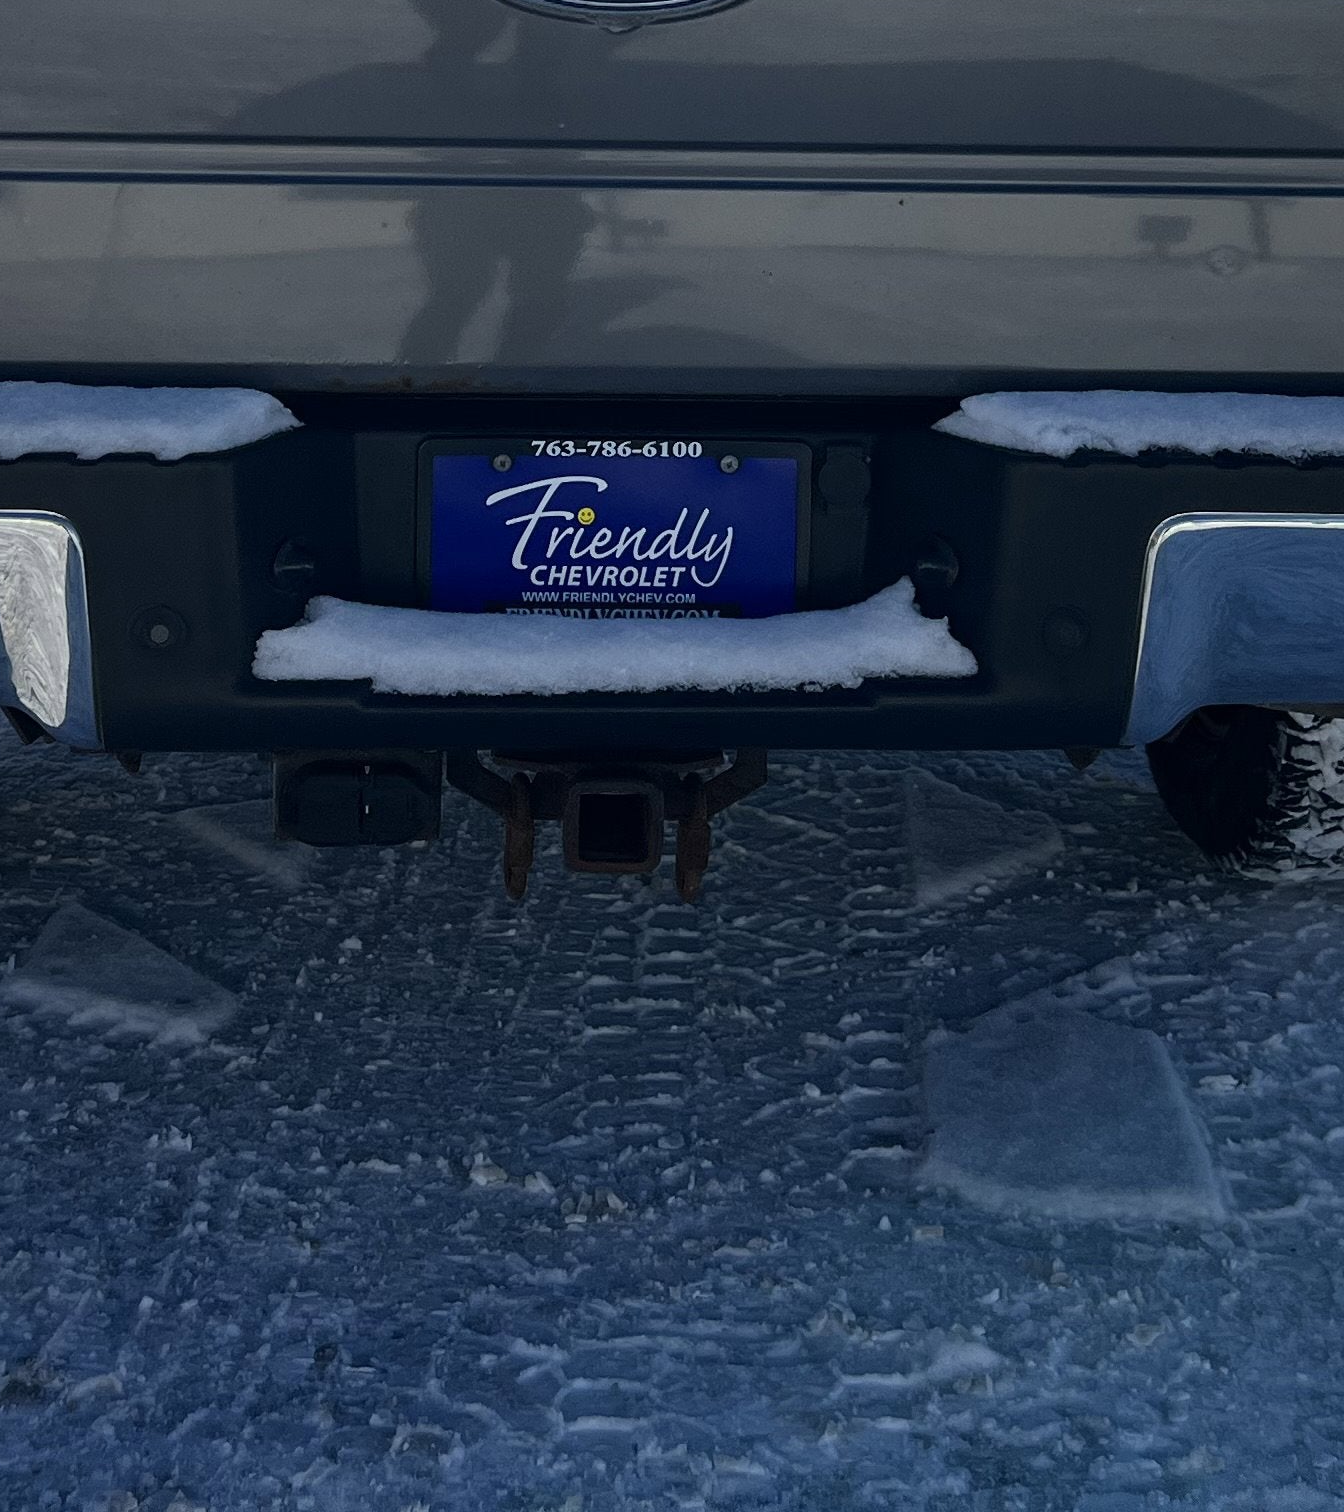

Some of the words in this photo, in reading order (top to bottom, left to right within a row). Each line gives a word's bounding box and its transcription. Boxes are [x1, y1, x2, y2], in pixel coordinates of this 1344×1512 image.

[531, 439, 703, 458] 763-786-6100
[485, 475, 734, 588] Friendly
[530, 564, 687, 587] CHEVROLET
[521, 591, 697, 605] WWW.FRIENDLYCHEV.COM
